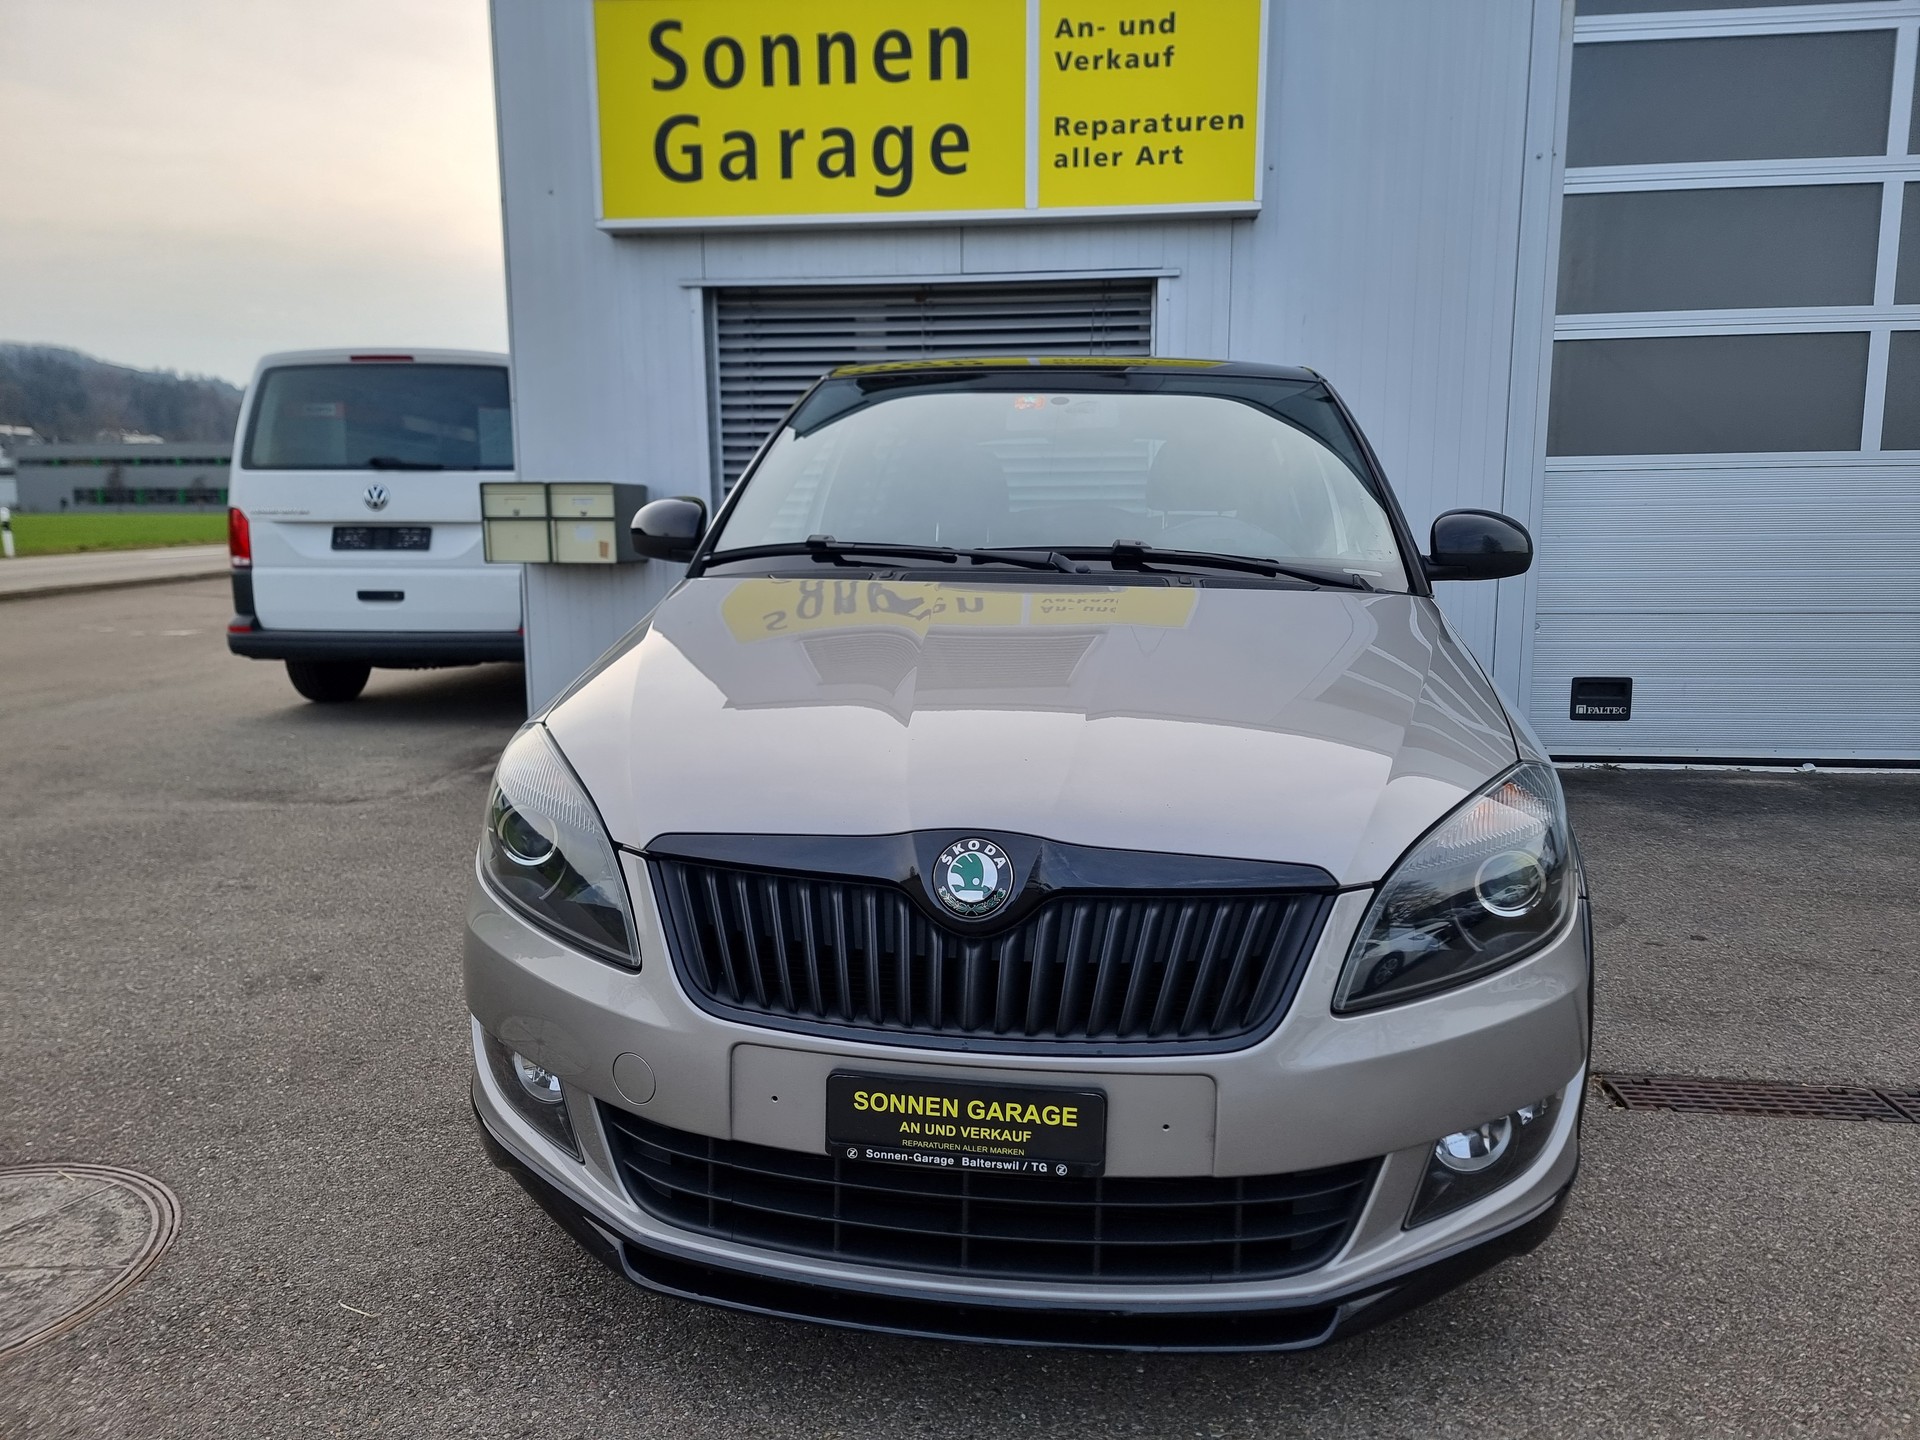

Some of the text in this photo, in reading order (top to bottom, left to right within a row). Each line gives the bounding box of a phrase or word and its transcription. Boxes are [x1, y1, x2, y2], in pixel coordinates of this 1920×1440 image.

[1055, 11, 1177, 39] An- und
[648, 18, 970, 92] Sonnen
[1055, 46, 1176, 72] Verkauf
[1053, 108, 1246, 141] Reparaturen
[653, 113, 971, 198] Garage
[1053, 145, 1184, 169] aller Art
[1587, 706, 1627, 715] FALTEC
[853, 1091, 1078, 1127] SONNEN GARAGE
[899, 1121, 1032, 1143] AN UND VERKAUF
[866, 1149, 955, 1166] Sonnen-Garage
[962, 1158, 1020, 1171] Balterswil
[1031, 1162, 1048, 1173] TG
[902, 1139, 1025, 1157] REPARATUREN ALLER MARKEN
